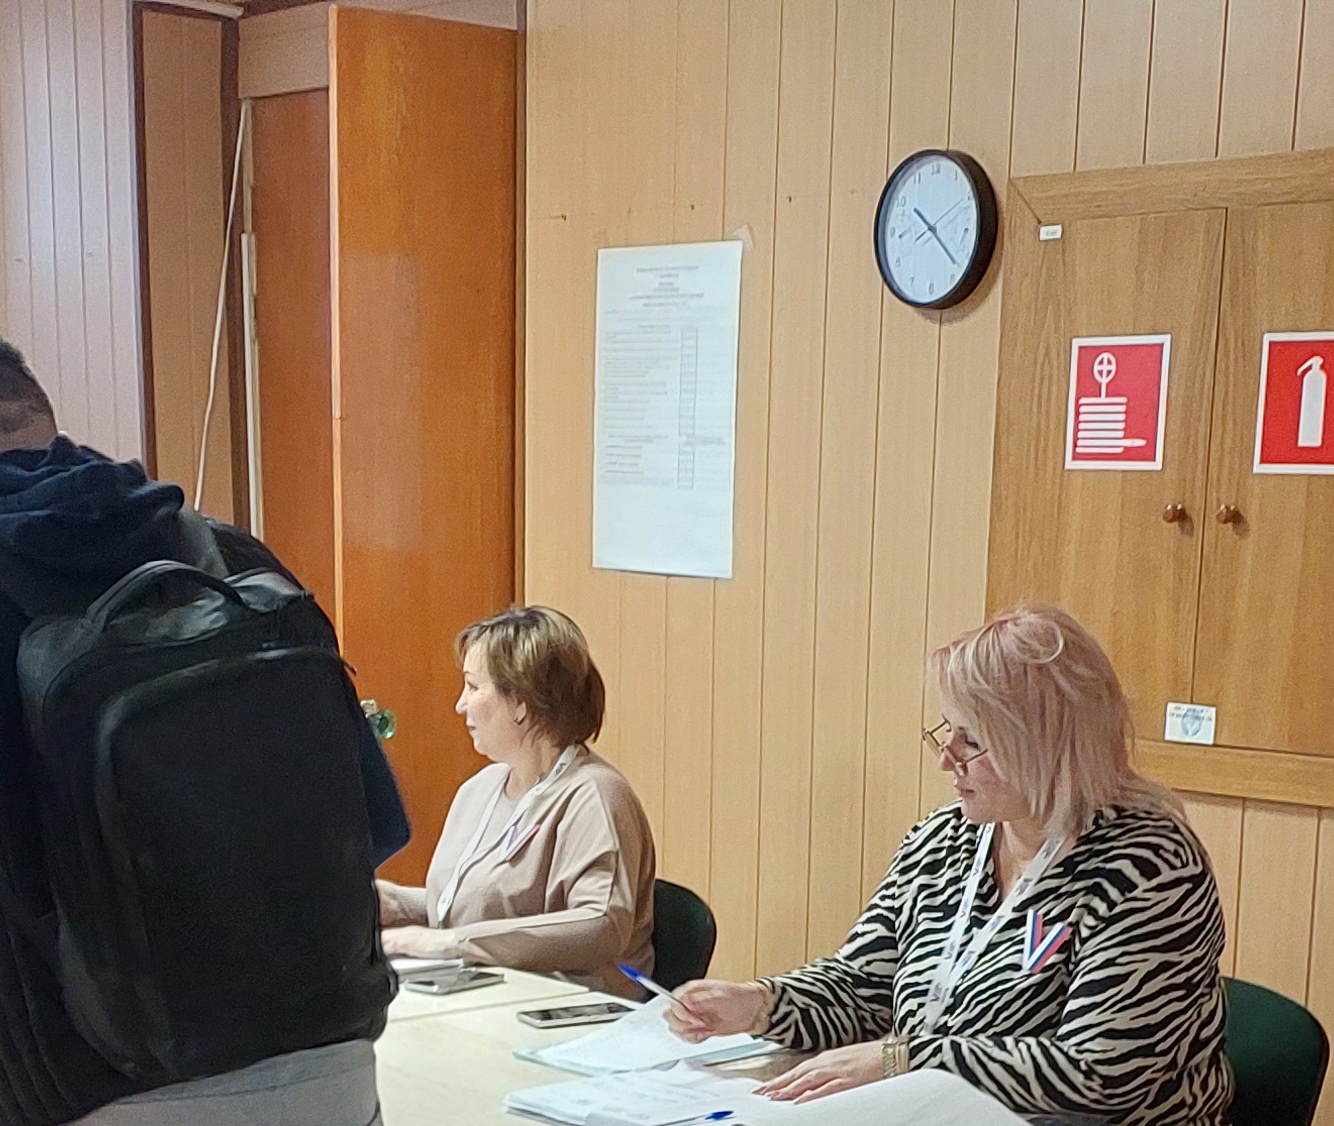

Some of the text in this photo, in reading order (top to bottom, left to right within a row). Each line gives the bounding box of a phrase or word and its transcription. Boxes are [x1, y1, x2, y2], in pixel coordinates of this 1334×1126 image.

[930, 163, 941, 175] 12
[913, 172, 921, 184] 11
[896, 196, 906, 208] 10
